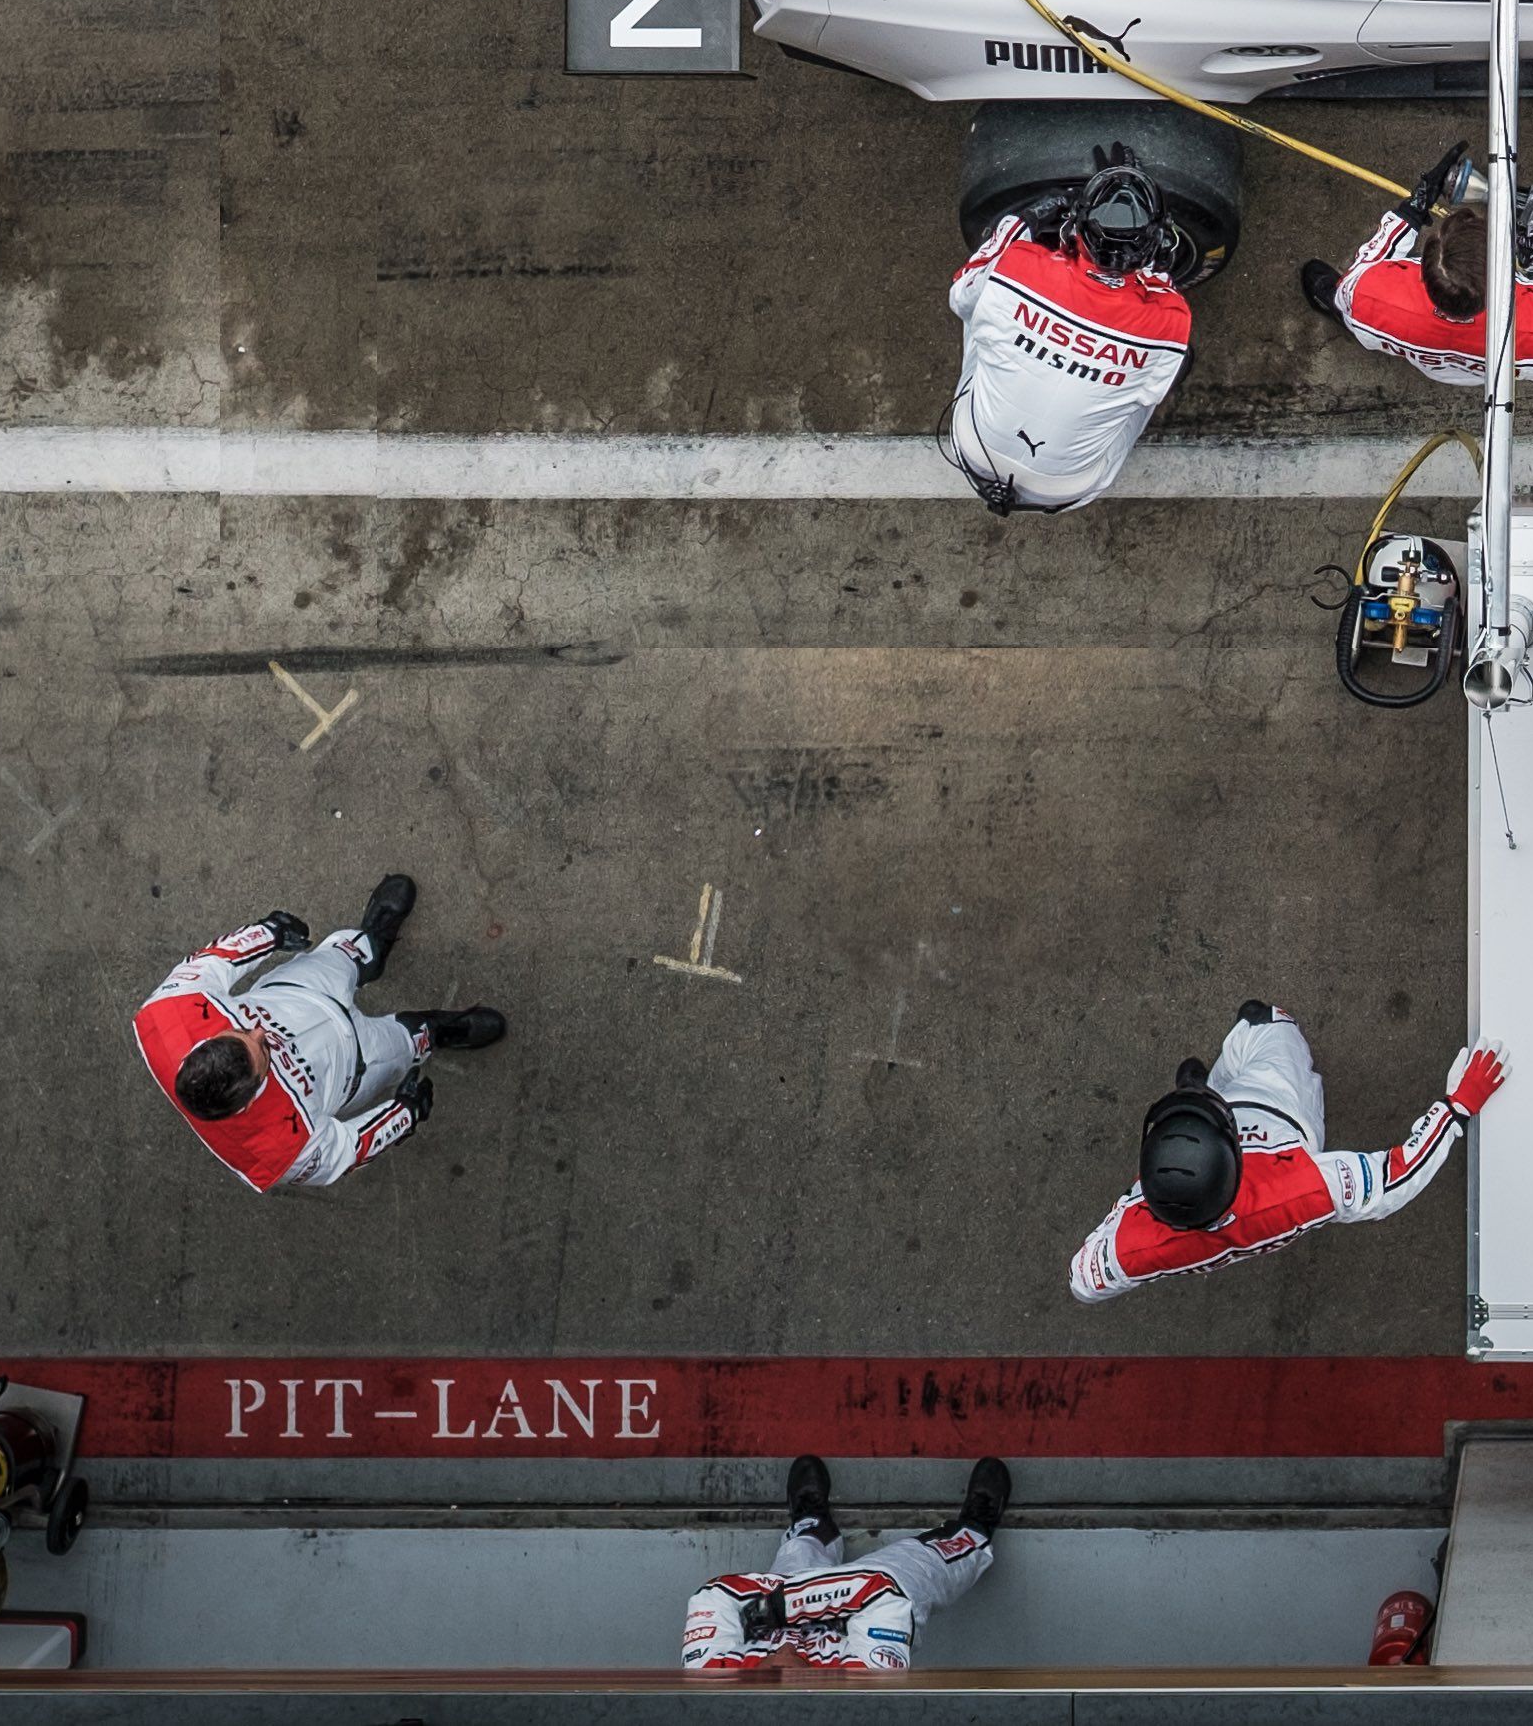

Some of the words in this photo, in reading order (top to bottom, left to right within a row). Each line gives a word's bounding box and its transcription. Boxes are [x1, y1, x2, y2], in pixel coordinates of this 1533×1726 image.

[984, 39, 1111, 74] PUMA
[1013, 301, 1149, 370] NISSAN
[1013, 332, 1127, 387] nismo
[1380, 340, 1488, 378] NISSA
[1342, 1162, 1355, 1202] BELL
[223, 1377, 662, 1440] PIT-LANE
[791, 1586, 852, 1609] nismo
